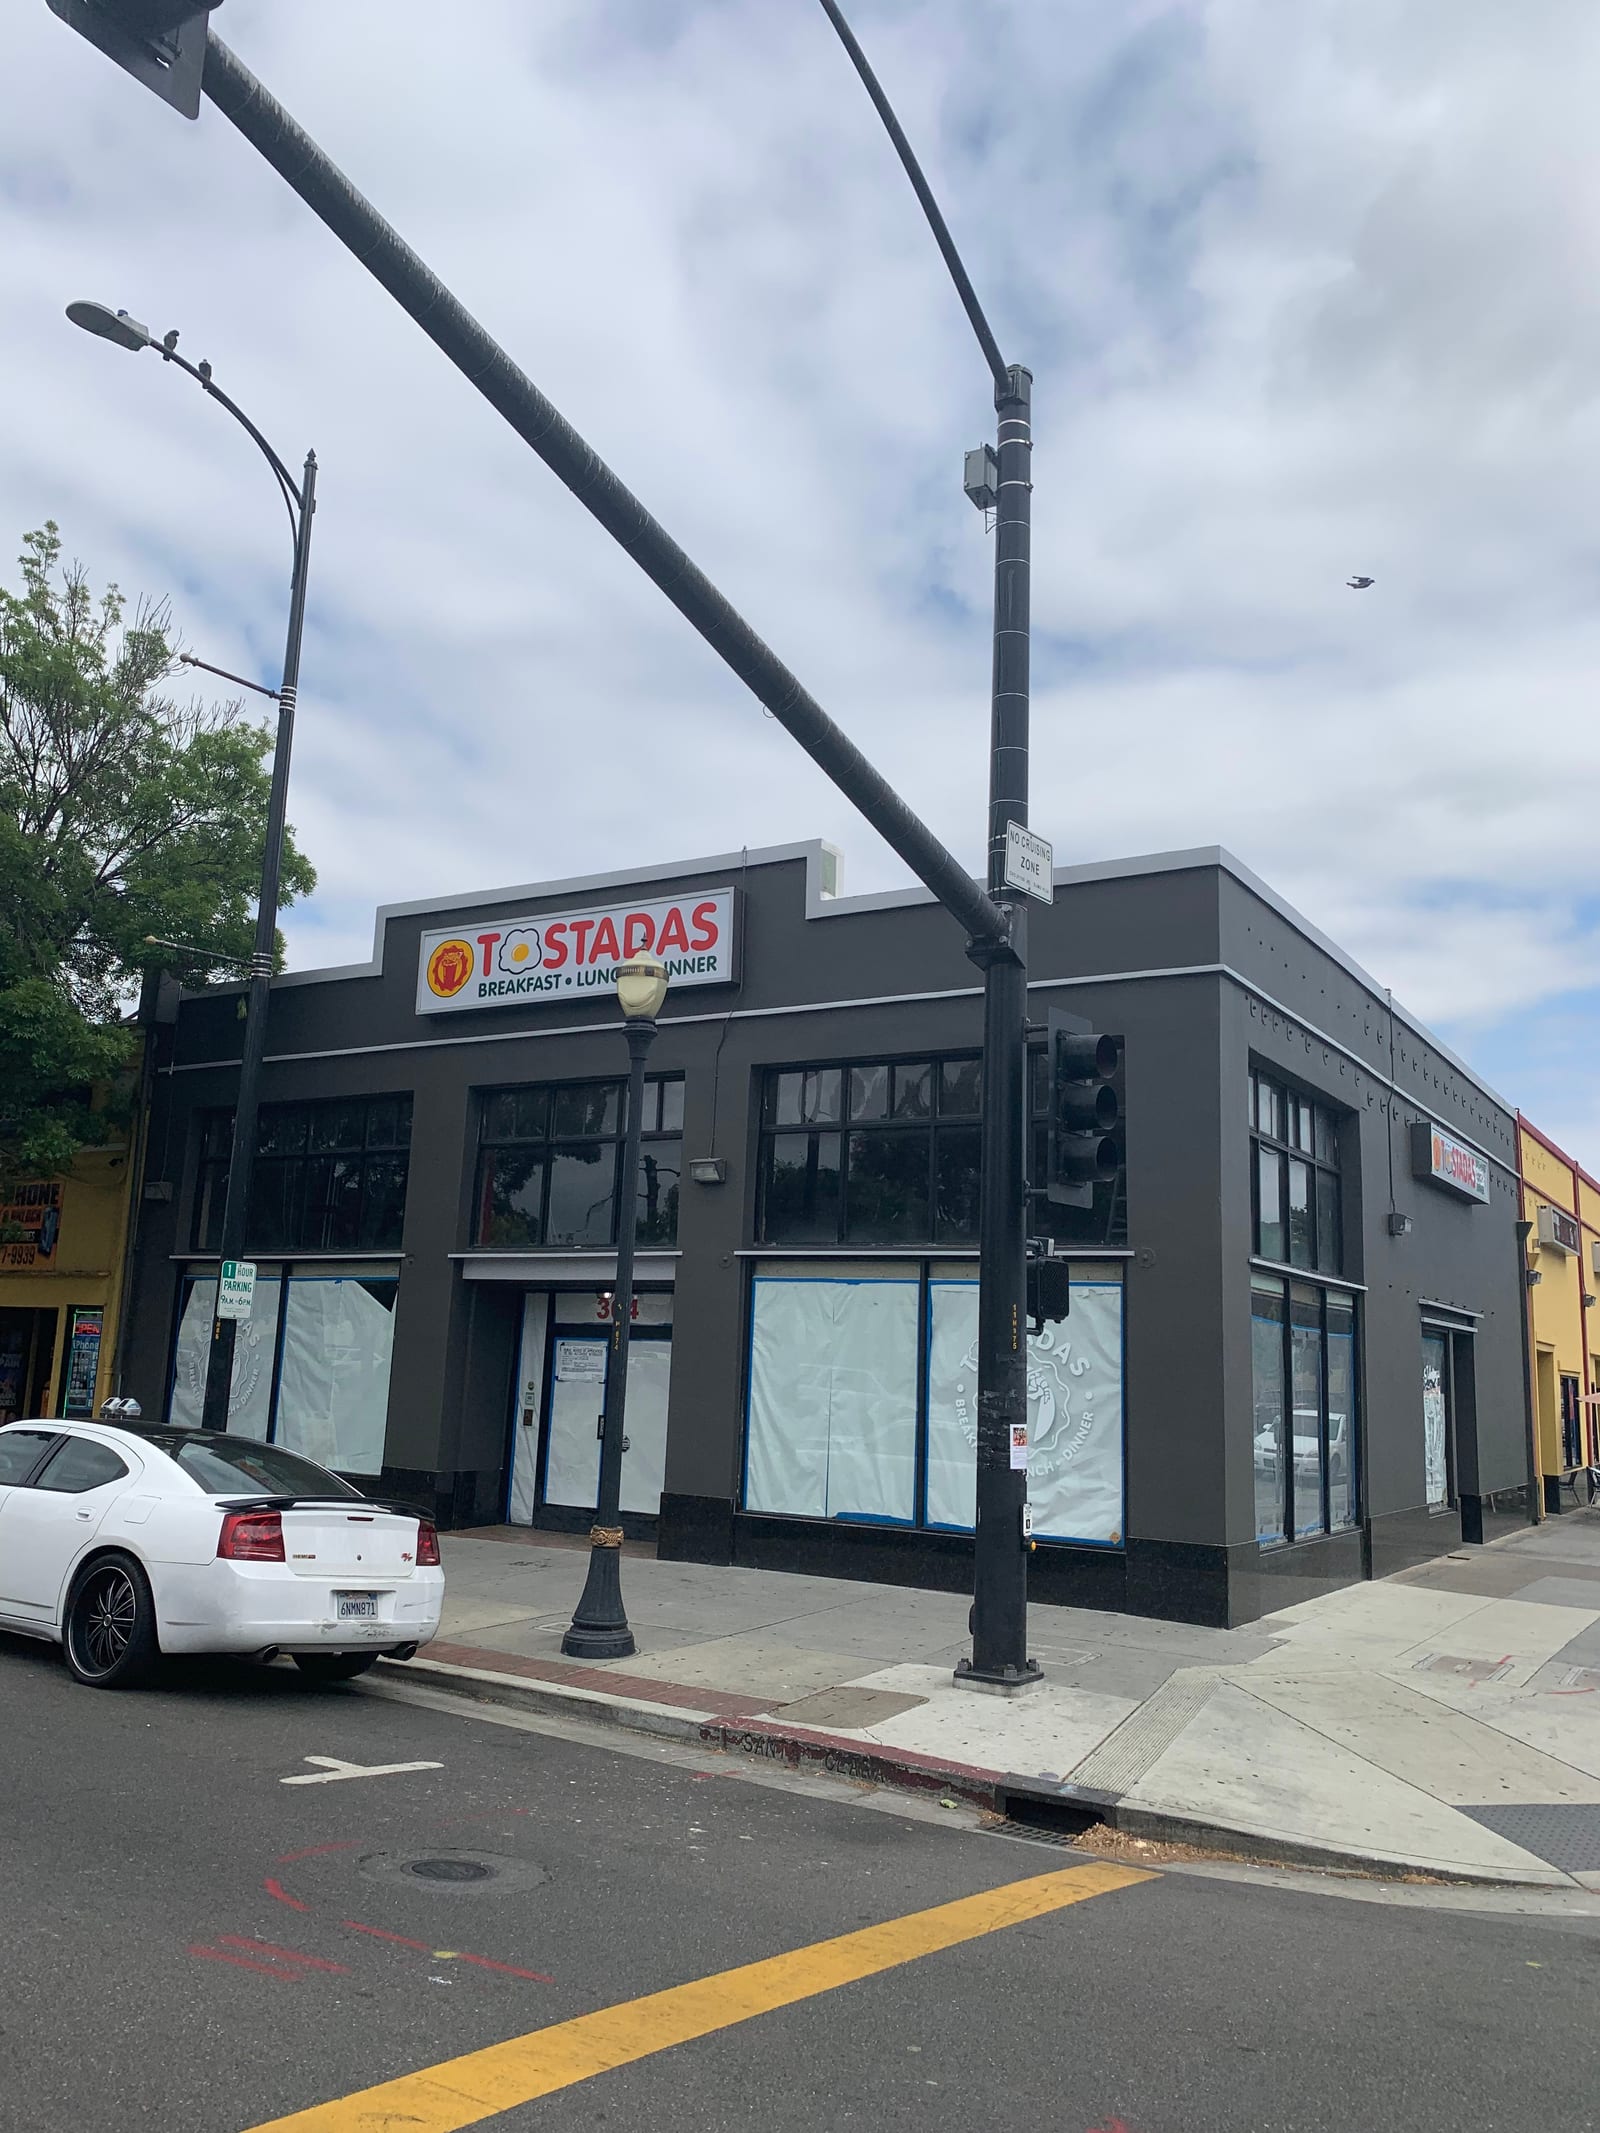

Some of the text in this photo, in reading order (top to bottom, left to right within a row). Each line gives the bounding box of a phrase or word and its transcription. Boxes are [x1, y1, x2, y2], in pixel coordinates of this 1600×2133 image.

[1010, 830, 1051, 862] NO CRUISING
[1020, 856, 1040, 876] ZONE
[478, 955, 718, 998] BREAKFAST LUNC INNER
[238, 1268, 254, 1278] HOUR
[223, 1280, 252, 1293] PARKING
[1062, 1410, 1094, 1461] DINNER
[341, 1601, 376, 1616] 6NMN871
